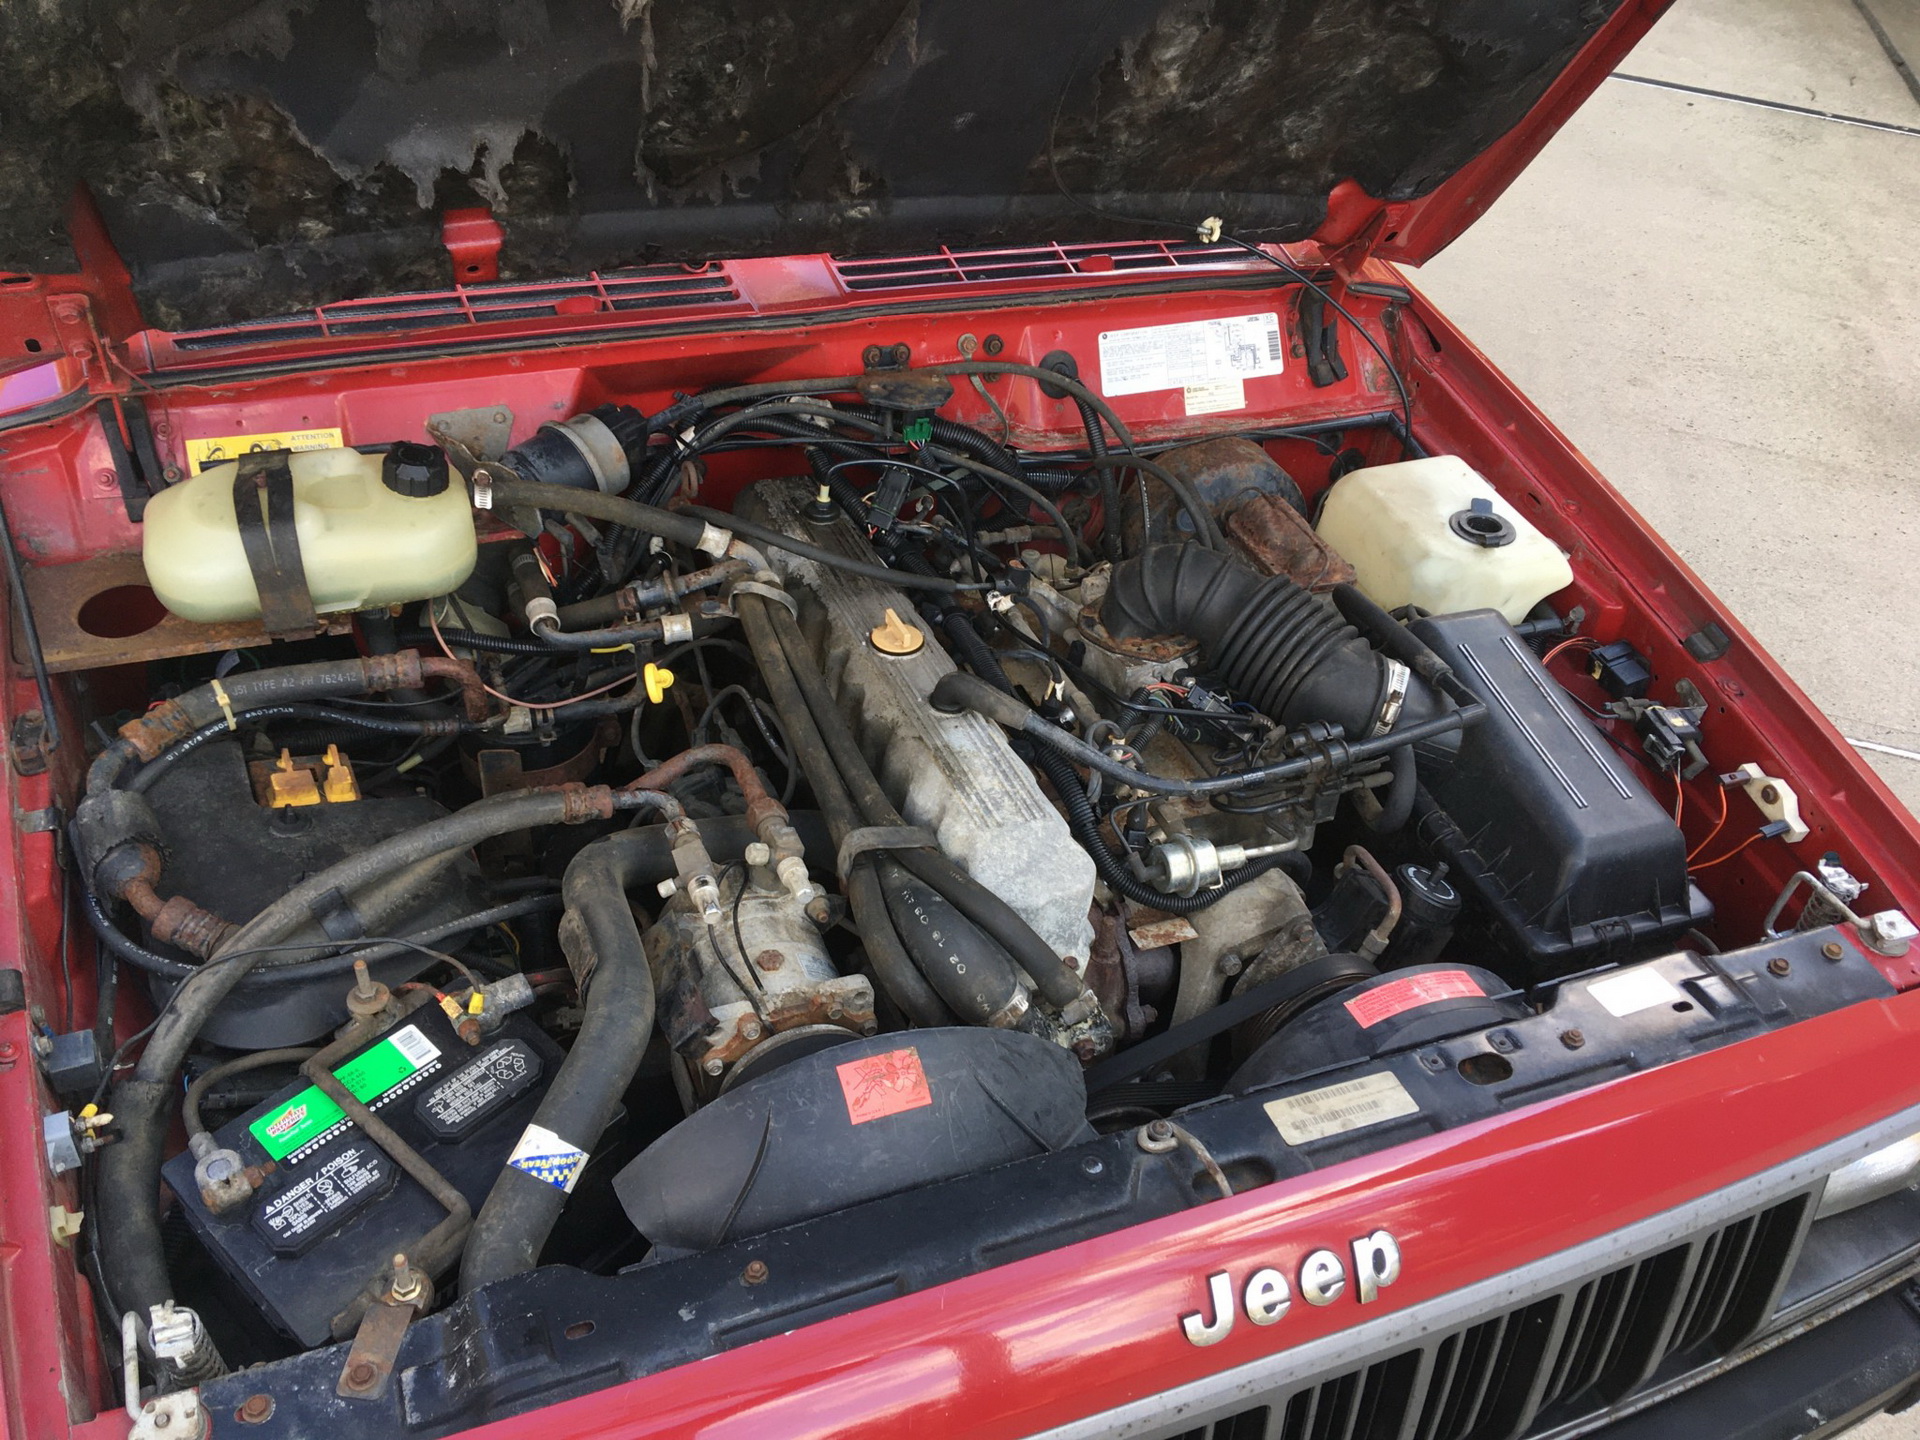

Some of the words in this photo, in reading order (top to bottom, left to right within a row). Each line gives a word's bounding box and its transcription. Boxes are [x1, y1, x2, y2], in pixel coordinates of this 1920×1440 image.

[290, 432, 335, 441] ATTENTION
[252, 678, 276, 692] TYPE
[366, 1159, 378, 1169] ACID
[273, 1177, 314, 1207] DANGER
[320, 1148, 357, 1175] POISON
[1181, 1229, 1401, 1347] Jeep
